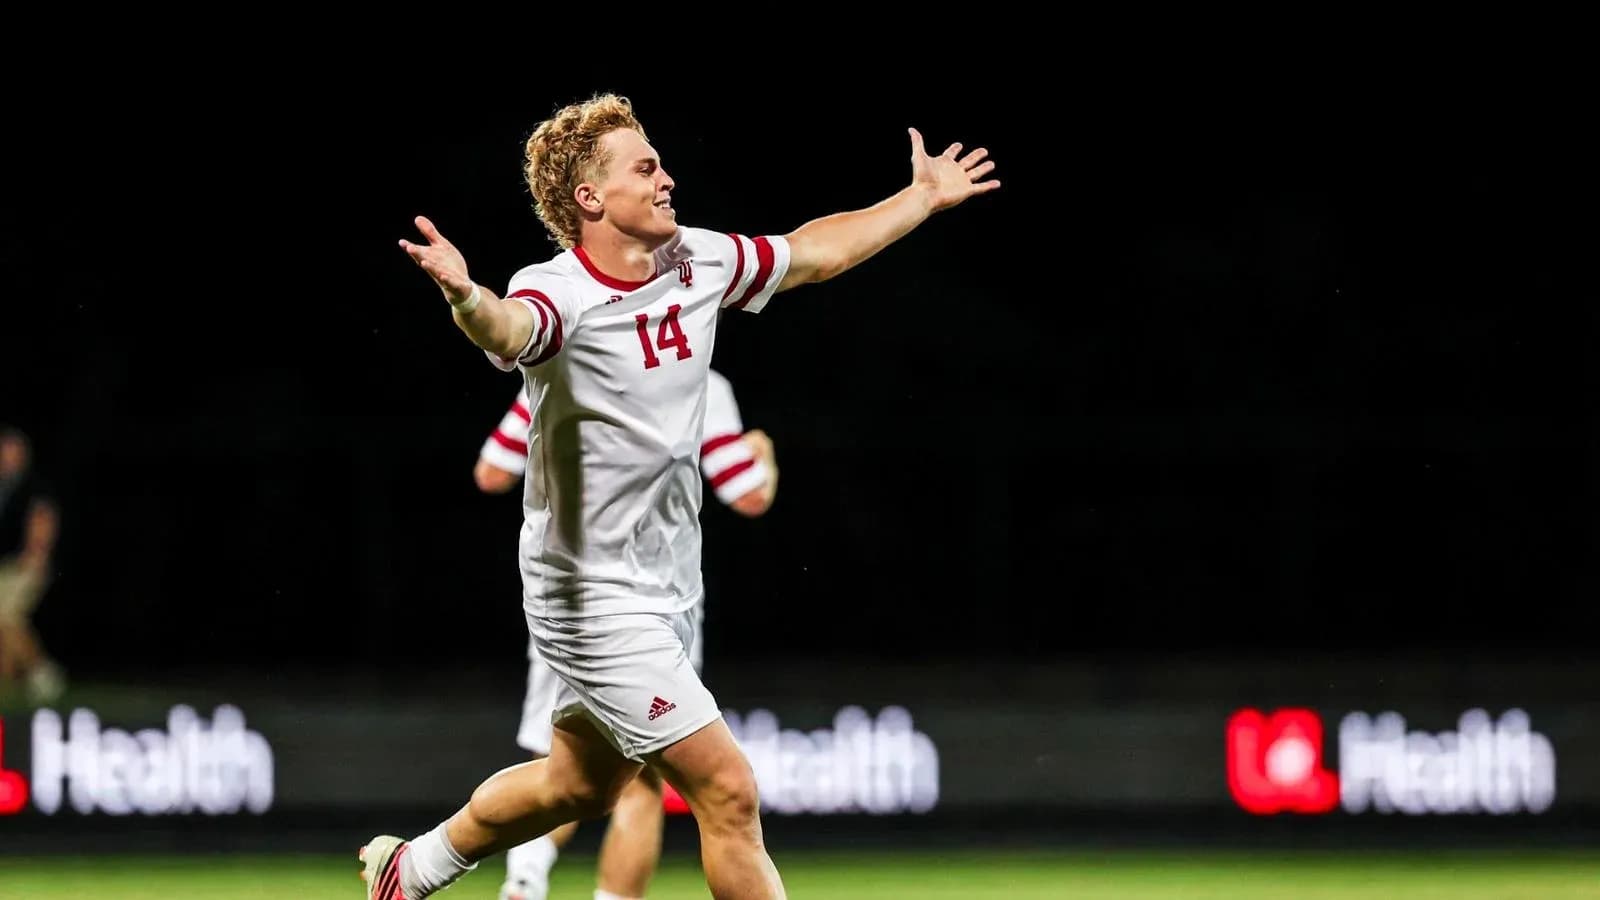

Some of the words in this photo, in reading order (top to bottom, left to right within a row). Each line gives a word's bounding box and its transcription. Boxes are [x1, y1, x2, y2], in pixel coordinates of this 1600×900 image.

[635, 304, 693, 369] 14
[648, 702, 677, 721] adidas
[31, 703, 275, 815] Health
[1338, 708, 1556, 815] Health
